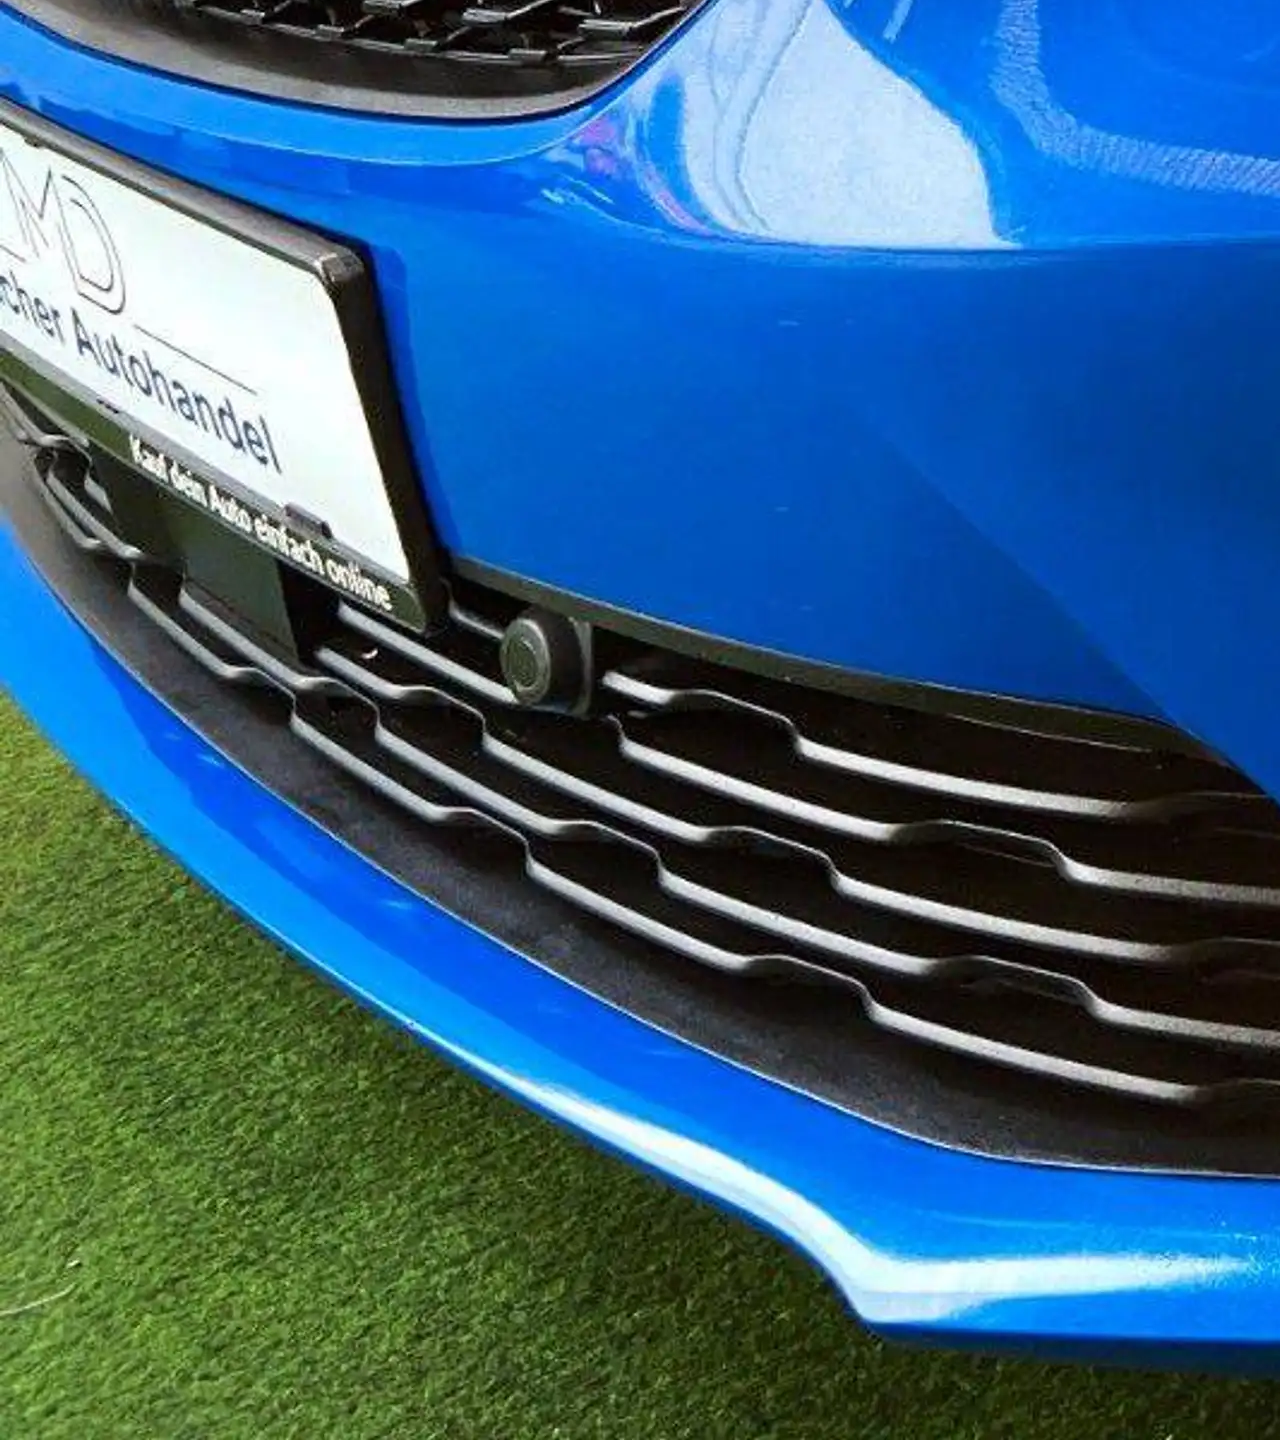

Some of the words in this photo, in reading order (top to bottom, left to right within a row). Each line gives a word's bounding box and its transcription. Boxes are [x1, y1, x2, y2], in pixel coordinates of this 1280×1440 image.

[71, 306, 282, 475] Autohandel
[207, 483, 252, 533] Auto
[325, 558, 392, 611] online
